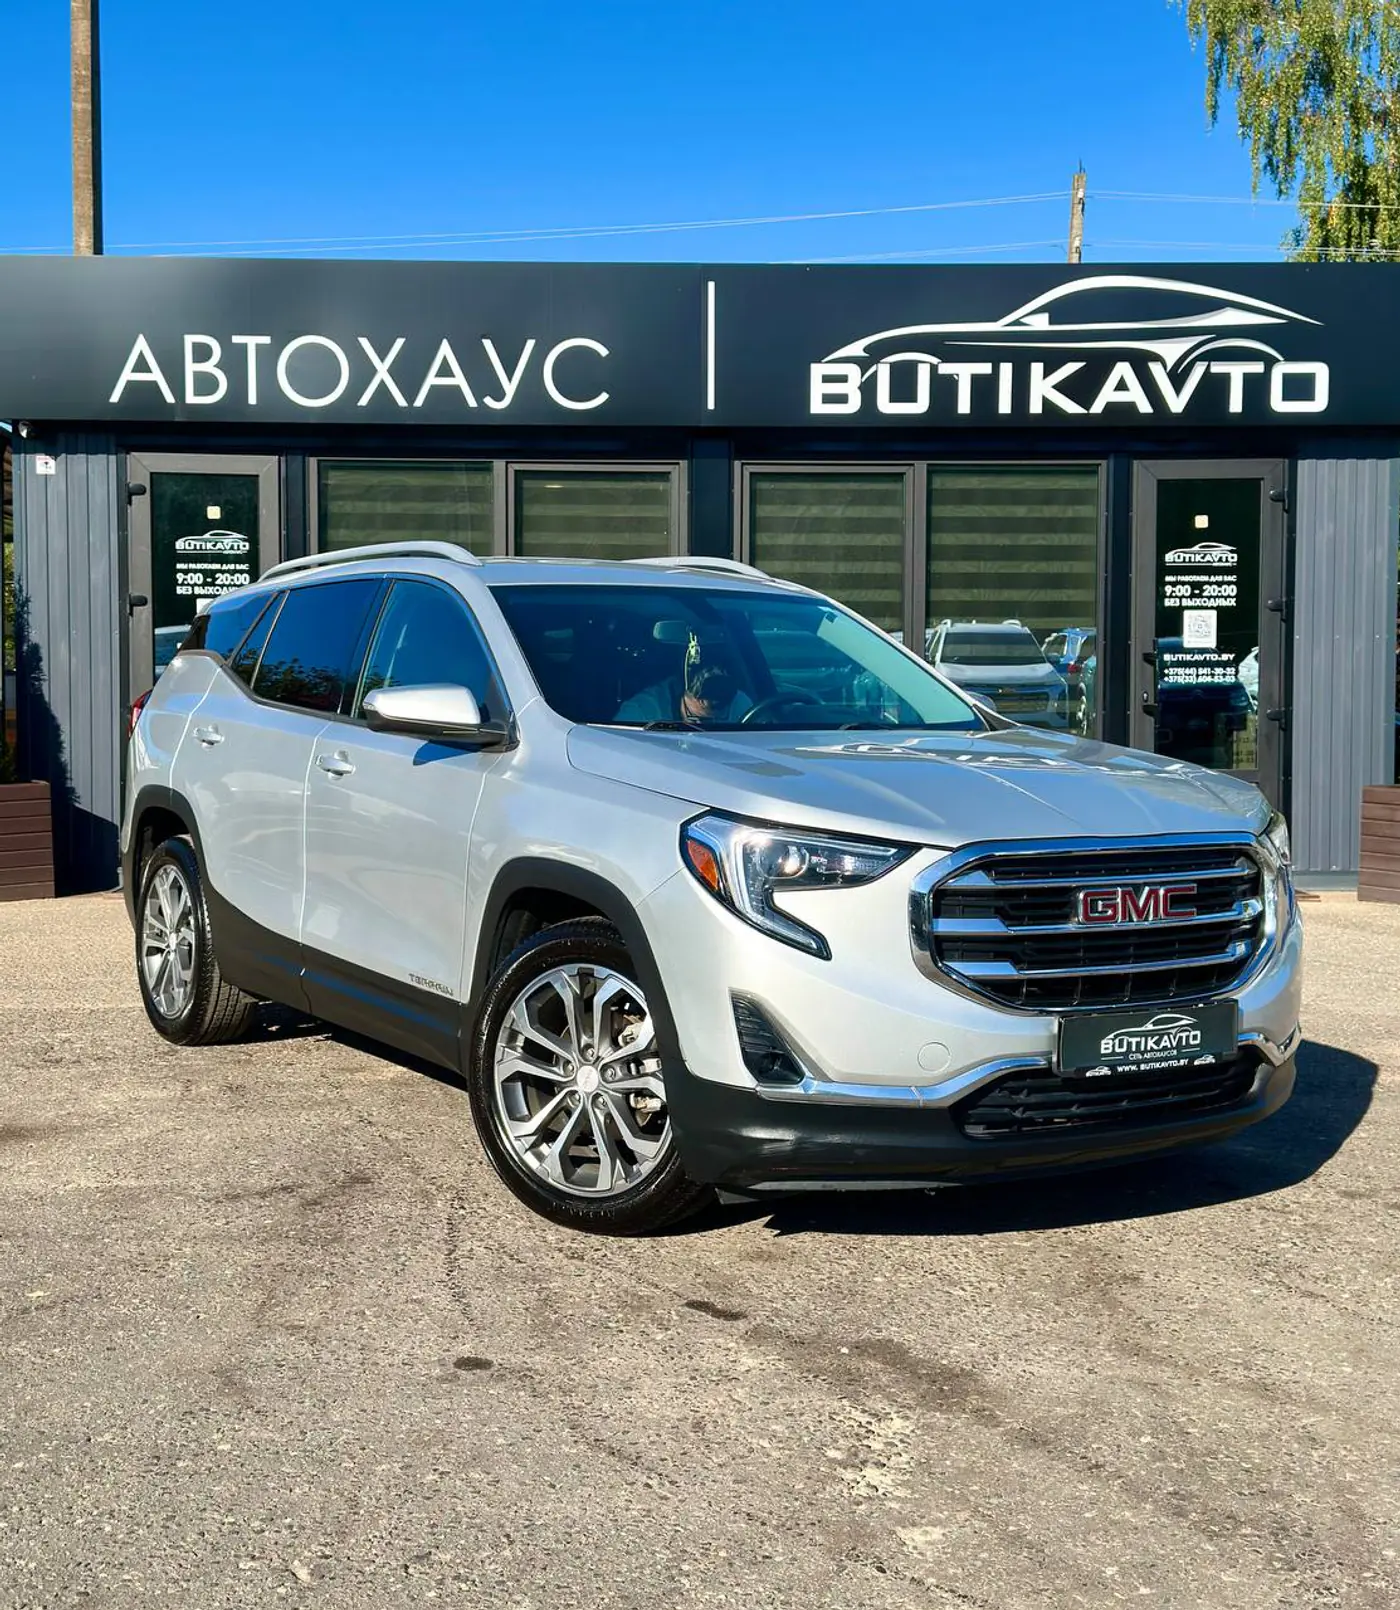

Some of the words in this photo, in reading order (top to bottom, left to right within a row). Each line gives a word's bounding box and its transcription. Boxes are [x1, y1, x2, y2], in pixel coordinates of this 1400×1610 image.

[109, 333, 610, 411] АВТОХАУС
[809, 360, 1329, 415] BUTIKAVTO
[176, 573, 203, 585] 9:00
[215, 573, 249, 585] 20:00
[176, 586, 192, 595] БЕЗ
[1165, 584, 1191, 597] 9:00
[1202, 584, 1237, 597] 20:00
[1164, 598, 1180, 606] БЕЗ
[1181, 598, 1236, 607] ВЫХОДНЫХ
[1078, 884, 1198, 924] GMC
[1100, 1030, 1201, 1054] BUTIKAVTO
